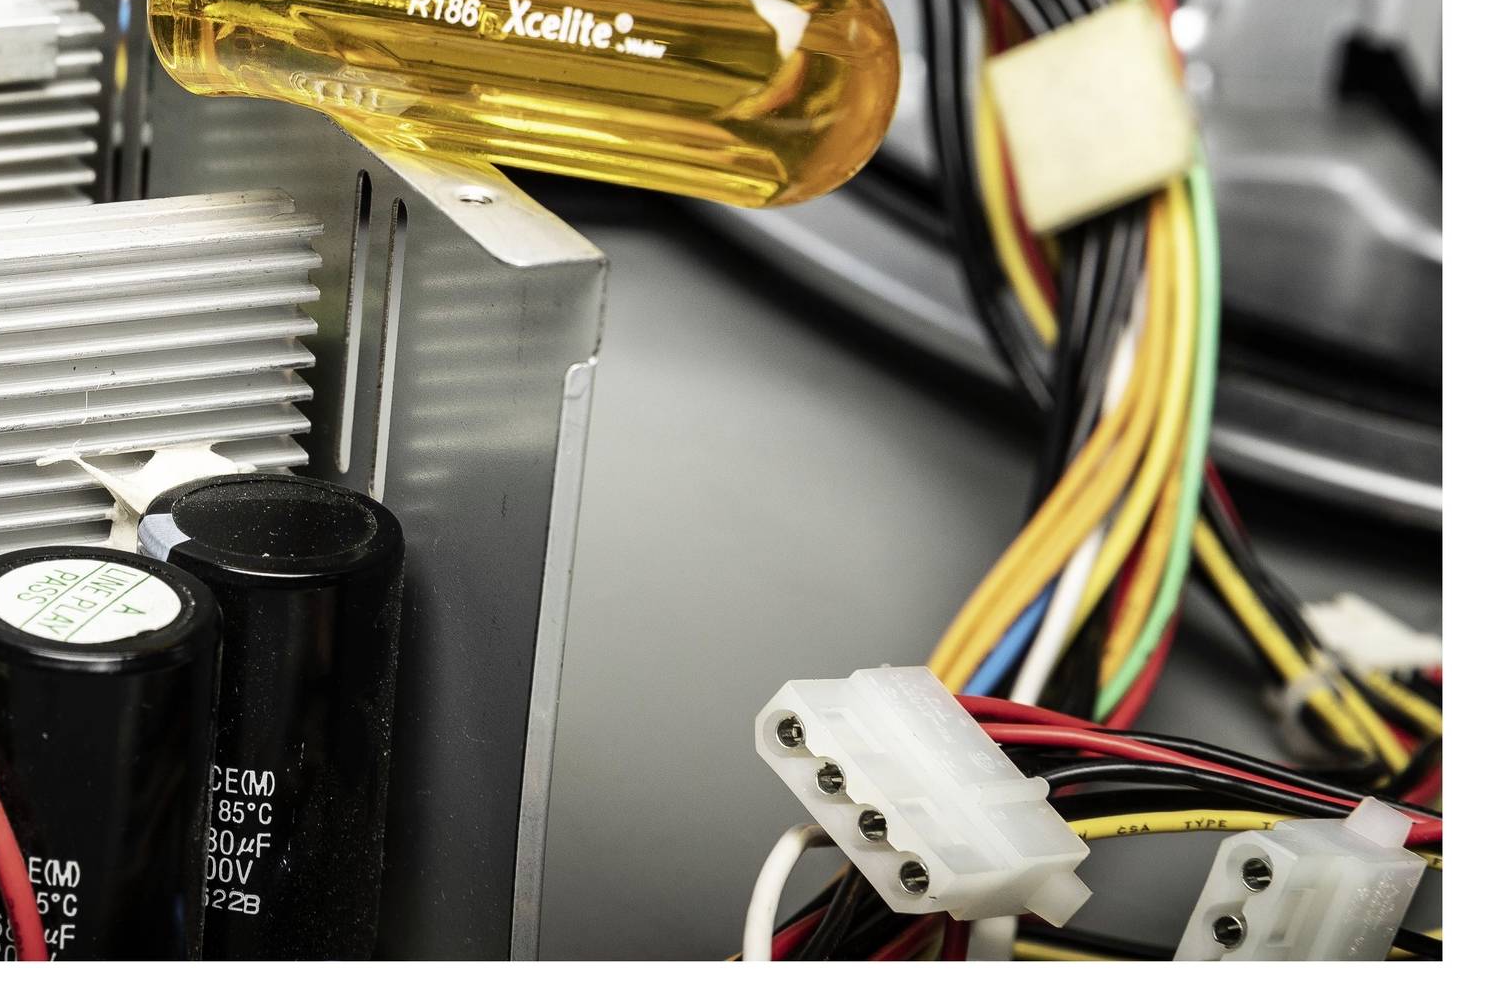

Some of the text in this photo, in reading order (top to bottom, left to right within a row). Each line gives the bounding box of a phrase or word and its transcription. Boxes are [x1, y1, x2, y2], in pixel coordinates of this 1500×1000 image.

[16, 569, 80, 605] PASS
[38, 567, 139, 635] LINE PLAY
[113, 603, 147, 616] A
[218, 799, 273, 825] 85°C
[1116, 823, 1151, 834] CSA
[1184, 819, 1228, 830] TYPE
[28, 856, 80, 888] E(M)
[36, 891, 78, 917] 5°C
